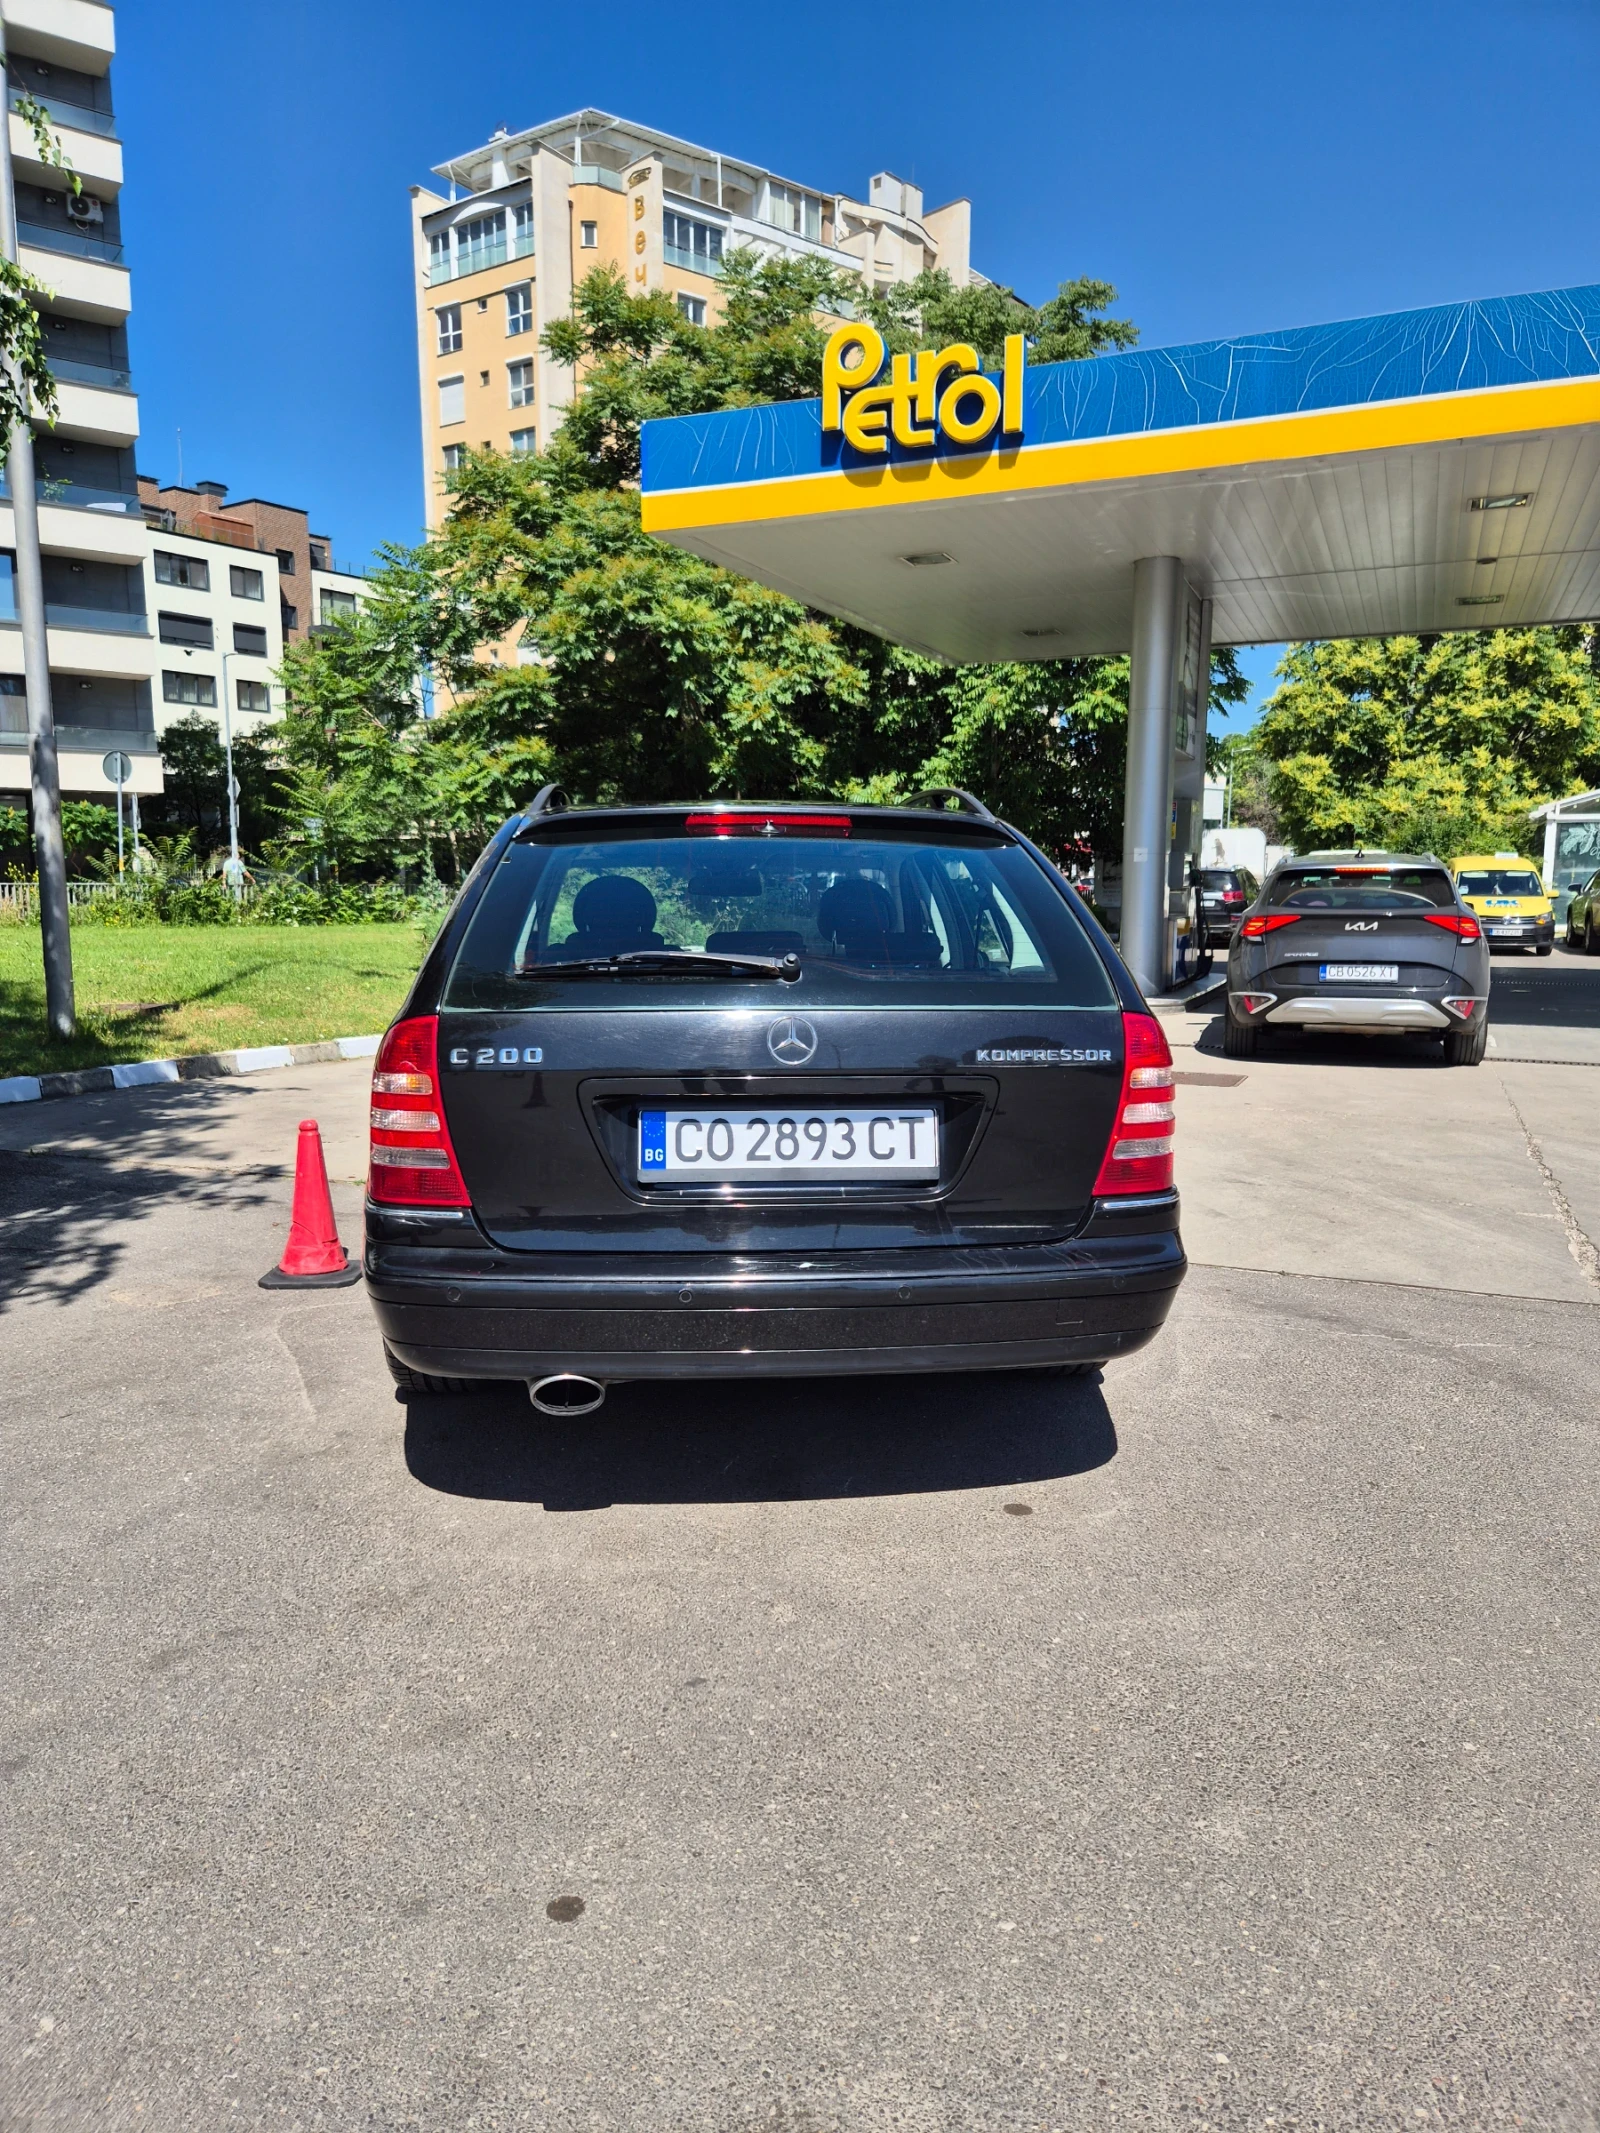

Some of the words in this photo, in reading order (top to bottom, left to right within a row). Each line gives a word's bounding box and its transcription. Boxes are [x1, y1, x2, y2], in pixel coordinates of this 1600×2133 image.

[822, 322, 1025, 453] Petrol
[1346, 966, 1377, 978] 0526
[1379, 966, 1396, 978] XT
[450, 1047, 469, 1065] C
[476, 1047, 543, 1065] 200
[976, 1049, 1112, 1062] KOMPRESSOR
[746, 1117, 857, 1162] 2893
[868, 1116, 925, 1160] CT
[644, 1148, 664, 1162] BG
